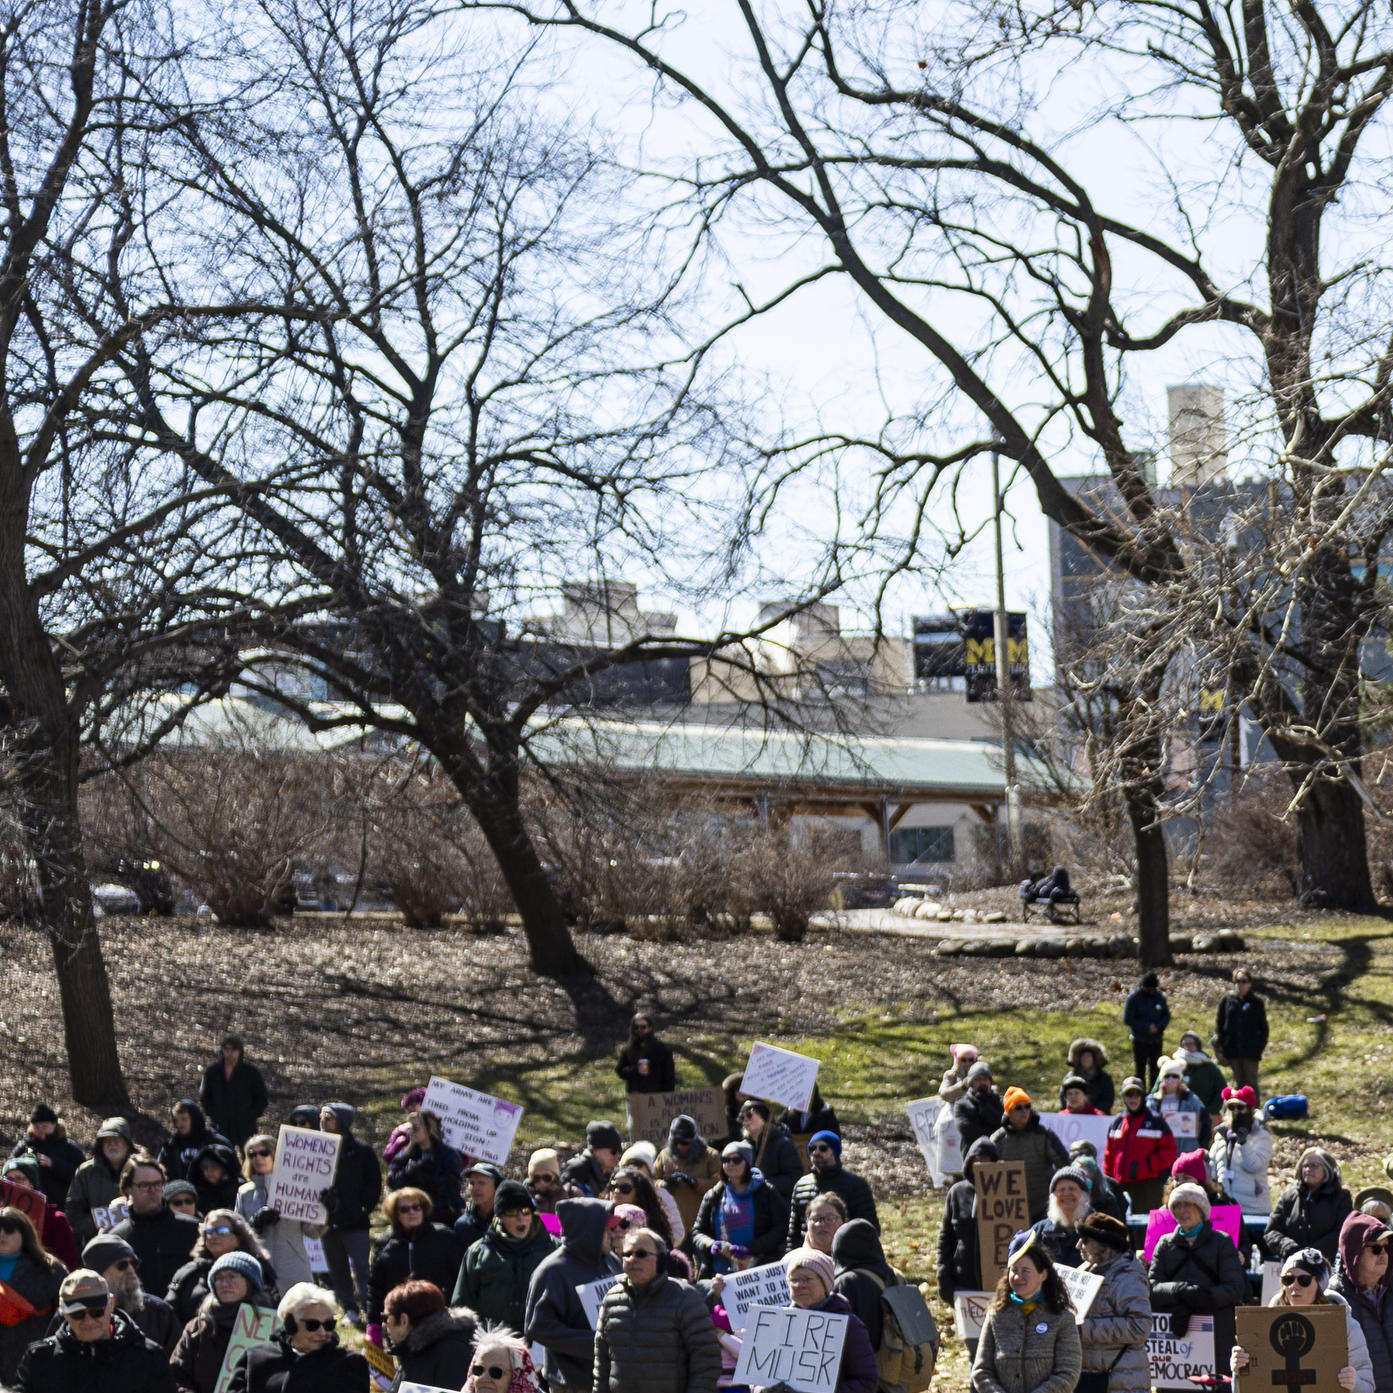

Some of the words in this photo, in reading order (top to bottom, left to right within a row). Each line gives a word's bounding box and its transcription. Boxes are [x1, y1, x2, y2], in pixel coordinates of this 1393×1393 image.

[281, 1151, 333, 1175] RIGHTS
[291, 1172, 309, 1184] are
[979, 1169, 1022, 1197] WE
[275, 1182, 321, 1203] HUMAN
[94, 1206, 130, 1229] RES
[274, 1198, 320, 1220] RIGHTS
[982, 1198, 1025, 1221] LOVE
[735, 1271, 761, 1287] GIRLS
[765, 1264, 786, 1278] JUST
[734, 1285, 761, 1302] WANT
[766, 1282, 777, 1294] TO
[753, 1310, 842, 1354] FIRE
[1144, 1340, 1180, 1355] STEAL
[745, 1345, 836, 1386] MUSK
[1149, 1362, 1213, 1380] EMOCRACY
